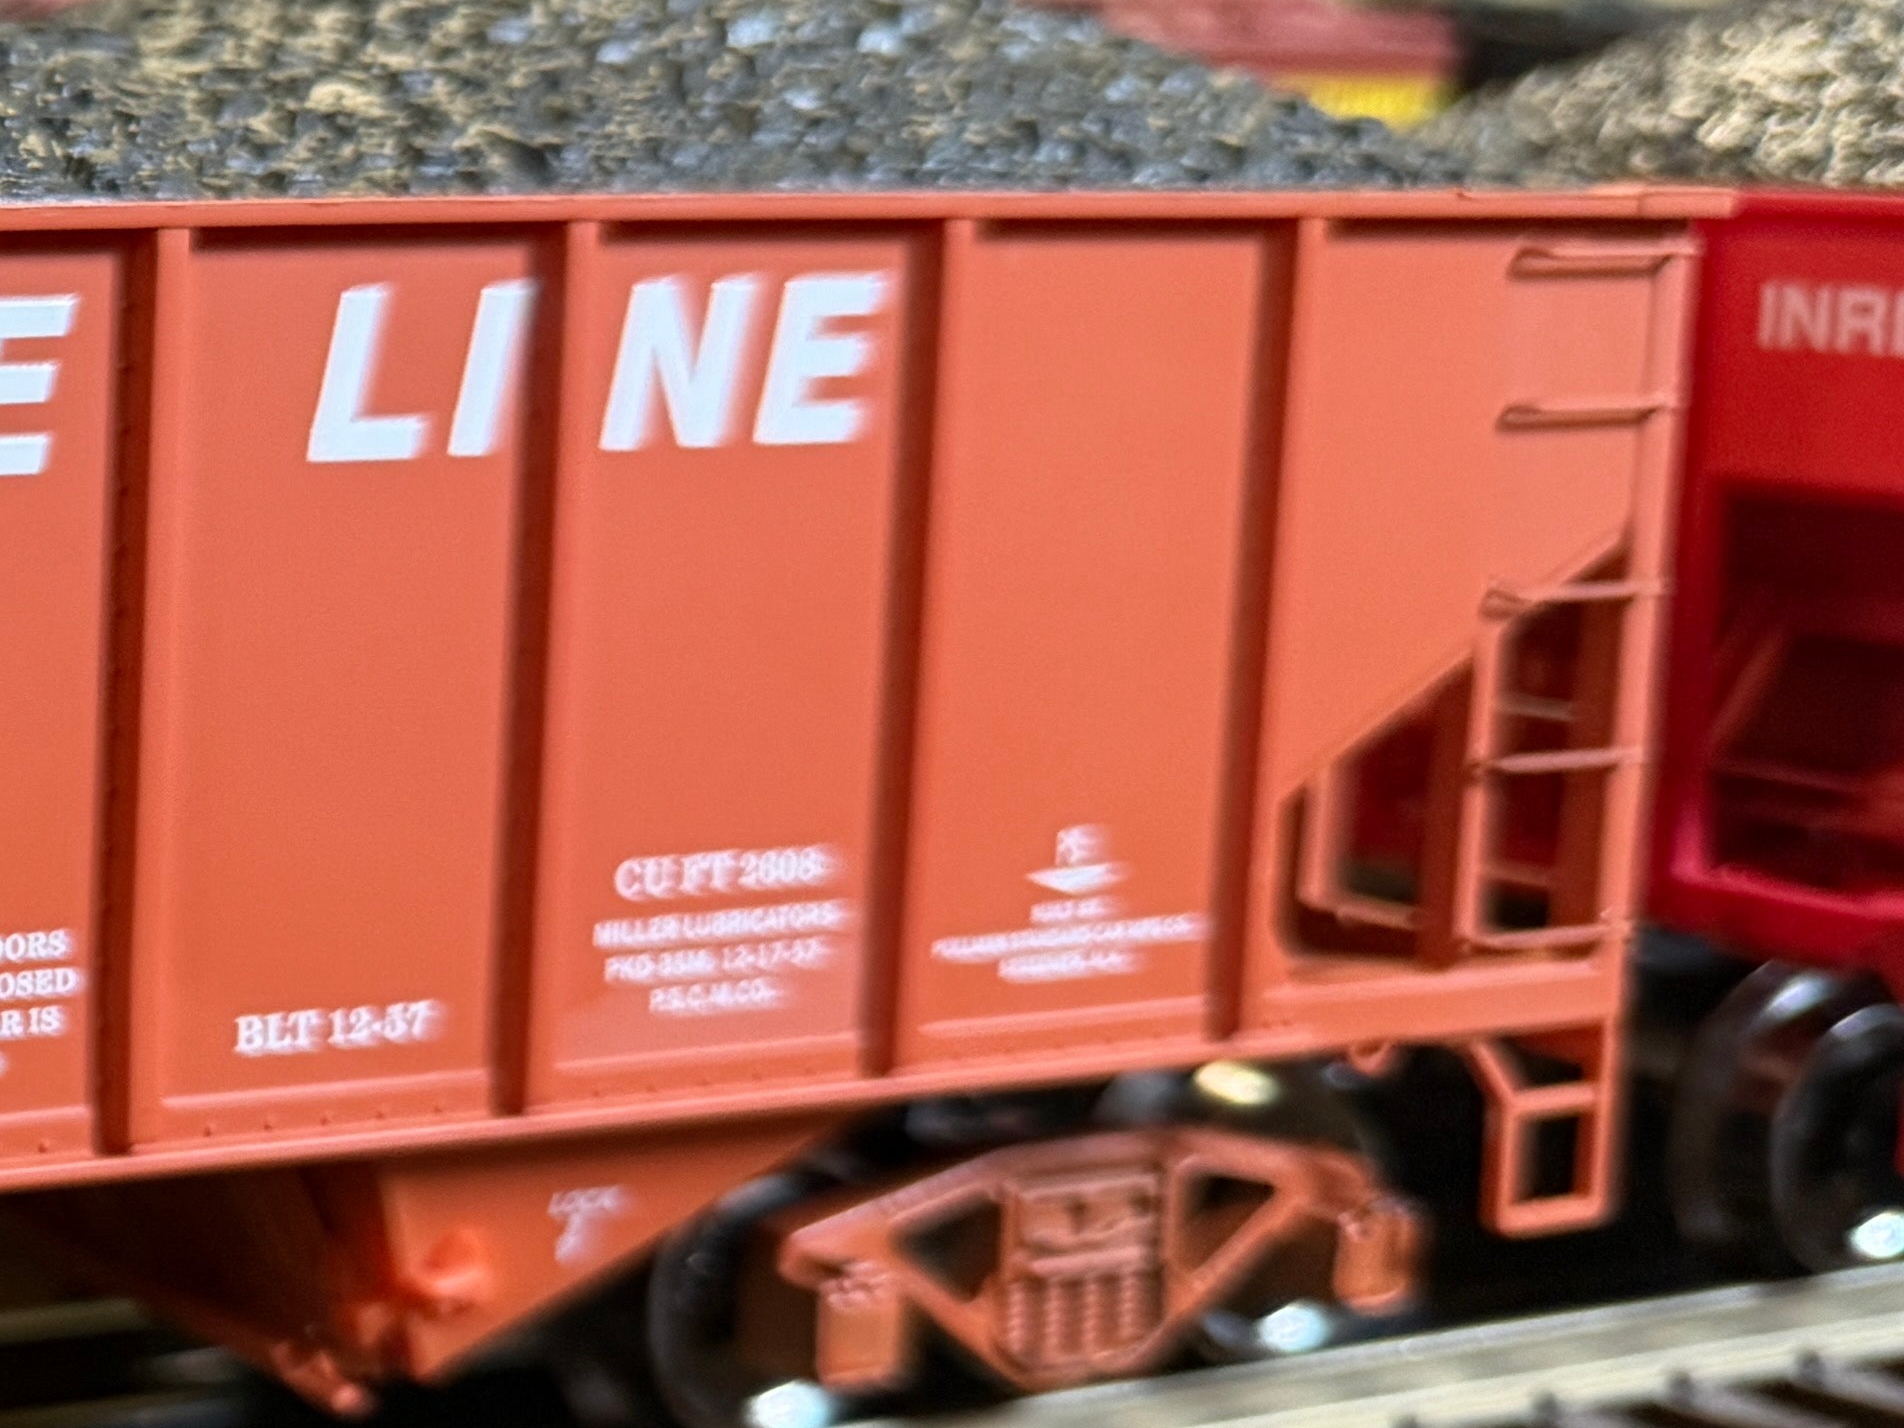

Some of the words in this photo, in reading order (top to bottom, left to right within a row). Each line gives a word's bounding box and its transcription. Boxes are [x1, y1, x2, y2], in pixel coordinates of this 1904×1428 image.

[1758, 283, 1904, 358] INR
[305, 269, 896, 464] LINE
[28, 1004, 66, 1036] IS
[233, 1007, 322, 1058] BLT
[327, 998, 442, 1049] 12-57
